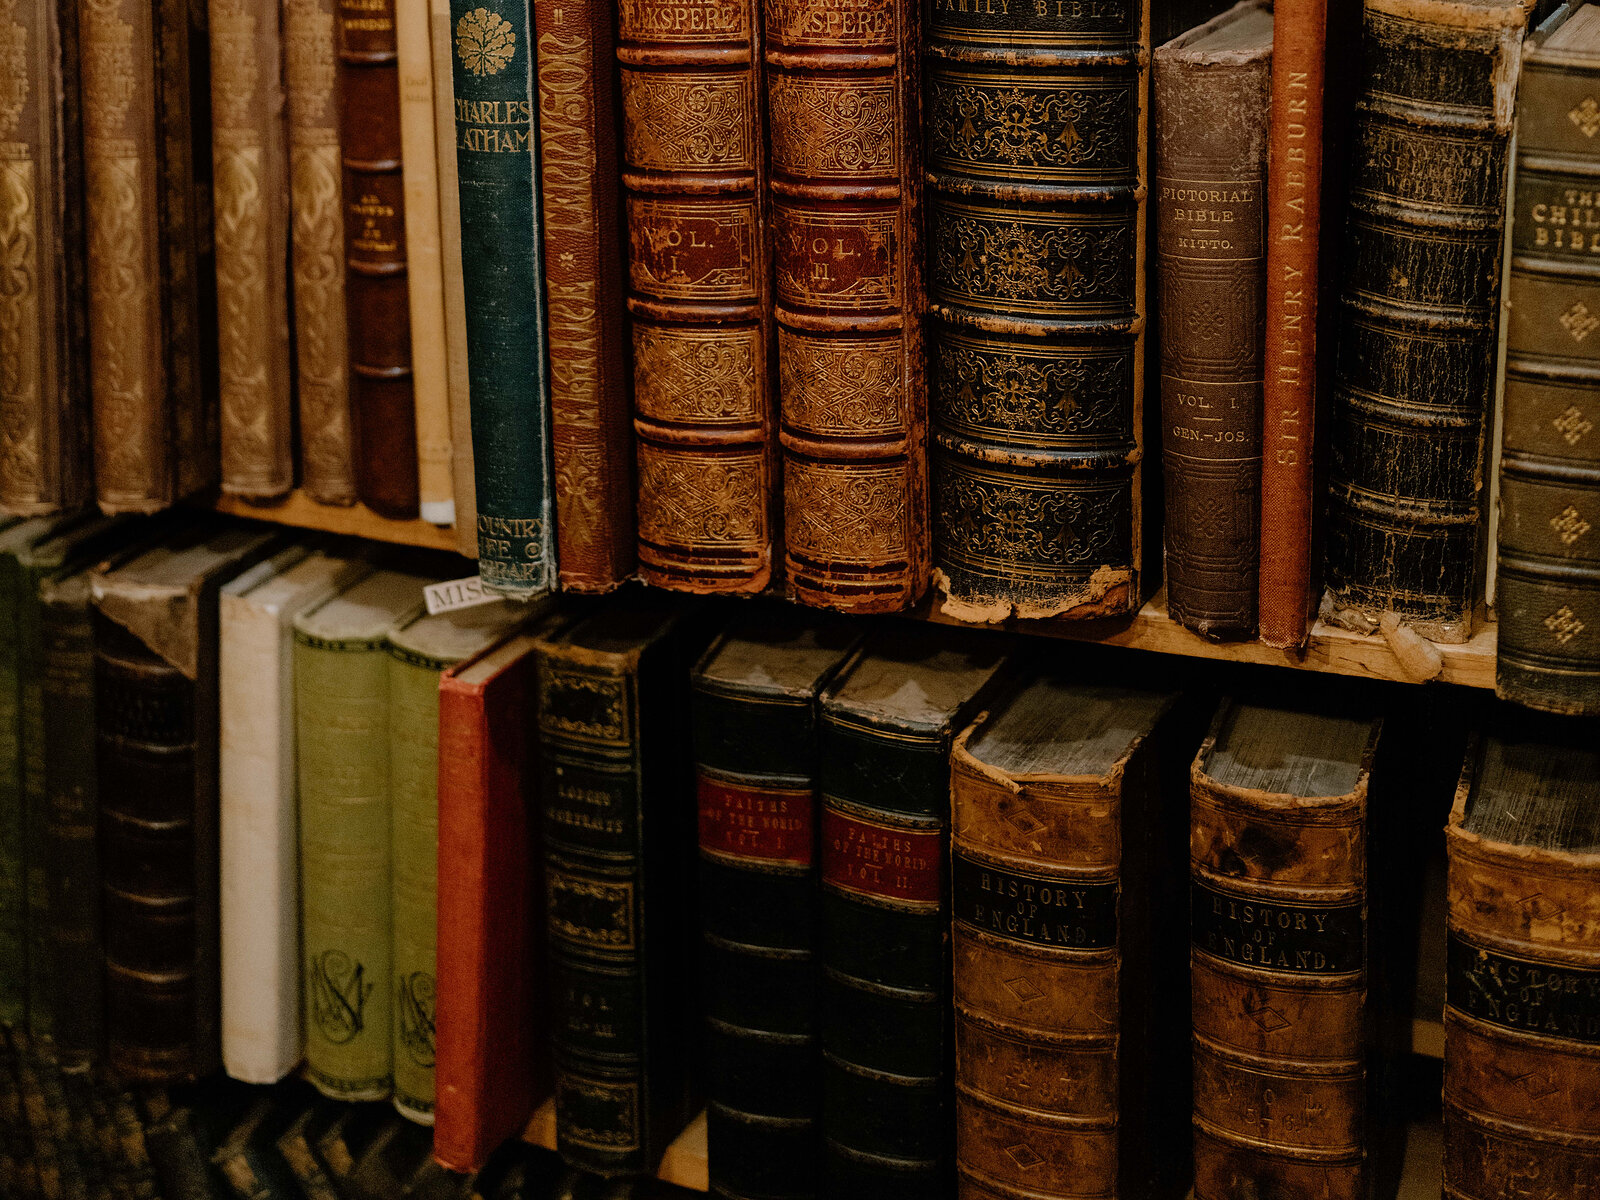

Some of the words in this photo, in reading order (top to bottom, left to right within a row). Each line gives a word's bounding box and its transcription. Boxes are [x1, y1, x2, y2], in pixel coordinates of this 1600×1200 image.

[457, 127, 533, 154] ATHAM
[1280, 71, 1308, 243] RAEBURN
[1162, 187, 1253, 202] PICTORIAL
[1174, 208, 1234, 222] BIBLE
[645, 227, 714, 251] VOL.
[788, 234, 862, 257] VOL.
[1178, 238, 1234, 249] KITTO.
[813, 262, 836, 281] II.
[1277, 264, 1304, 386] HENRY
[1177, 393, 1214, 409] VOL.
[1230, 398, 1240, 409] I.
[1277, 408, 1300, 467] SIR
[856, 845, 879, 862] THE
[979, 872, 1086, 909] HISTORY
[1015, 901, 1040, 918] OF
[1209, 896, 1329, 932] HISTORY
[1252, 929, 1276, 946] OF
